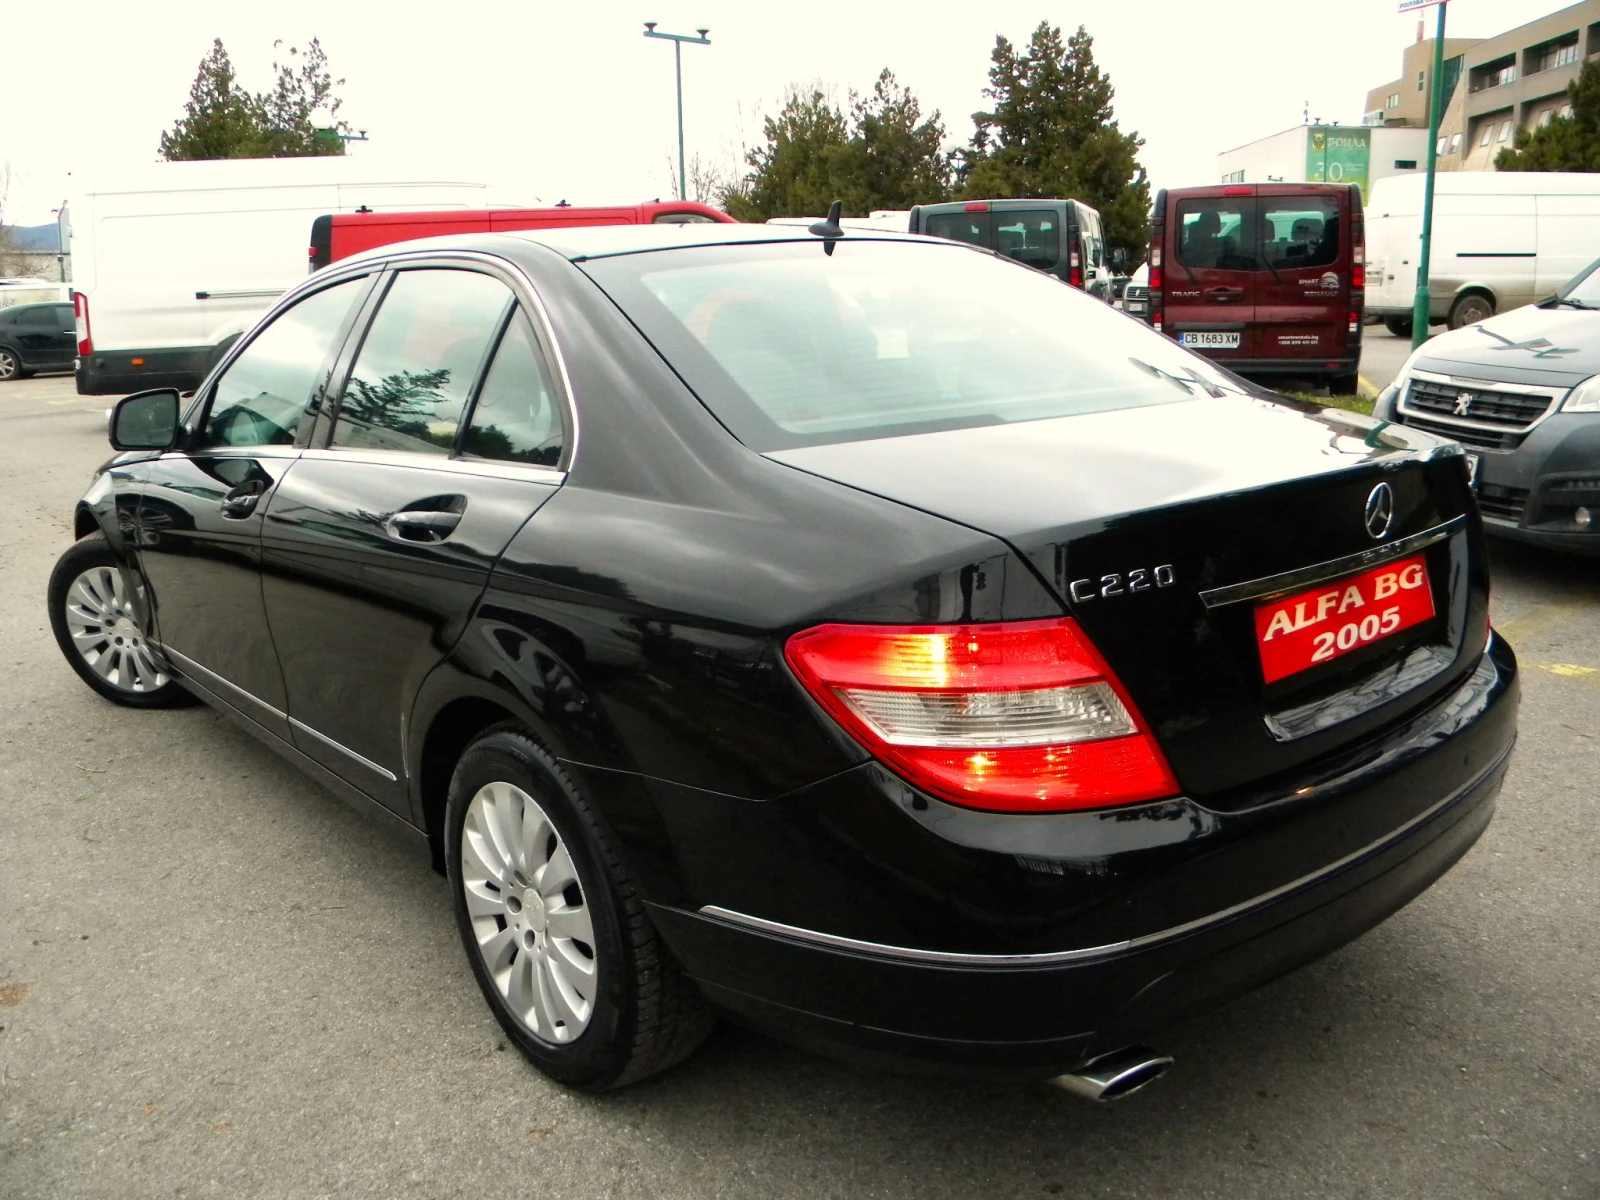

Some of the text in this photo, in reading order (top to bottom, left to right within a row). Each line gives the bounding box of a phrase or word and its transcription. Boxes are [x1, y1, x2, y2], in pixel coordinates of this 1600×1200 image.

[1327, 137, 1367, 148] БОИЛА
[1185, 333, 1239, 344] CB 1683 XM
[1263, 564, 1423, 642] ALFA BG
[1310, 606, 1401, 662] 2005
